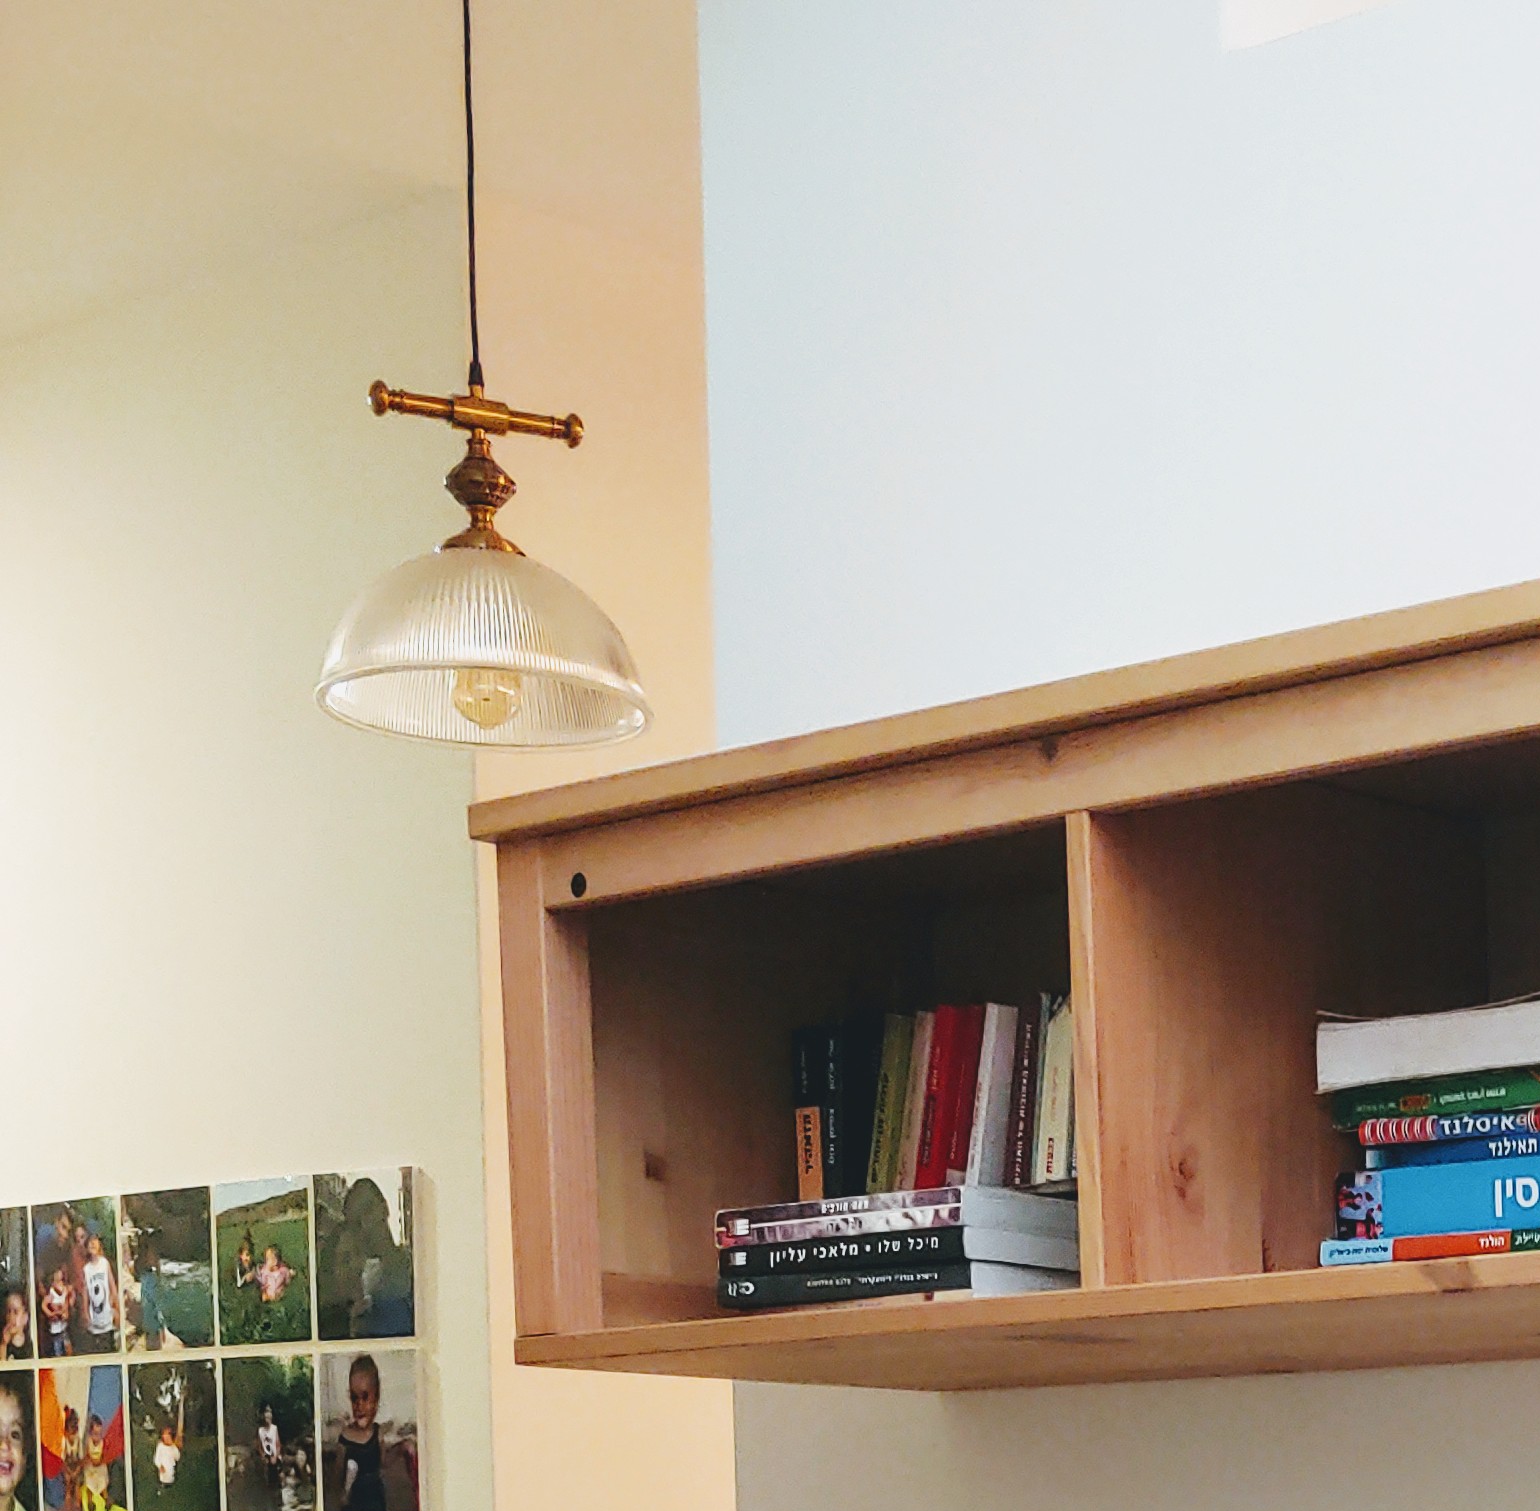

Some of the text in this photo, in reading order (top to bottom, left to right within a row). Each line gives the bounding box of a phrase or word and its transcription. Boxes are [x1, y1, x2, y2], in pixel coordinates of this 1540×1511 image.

[1440, 1115, 1515, 1135] איסלנד
[1489, 1137, 1537, 1157] תאילנד
[1495, 1177, 1539, 1217] סין
[1479, 1235, 1505, 1247] הולנד
[769, 1235, 939, 1268] מיכל שלו מלאכי עליון
